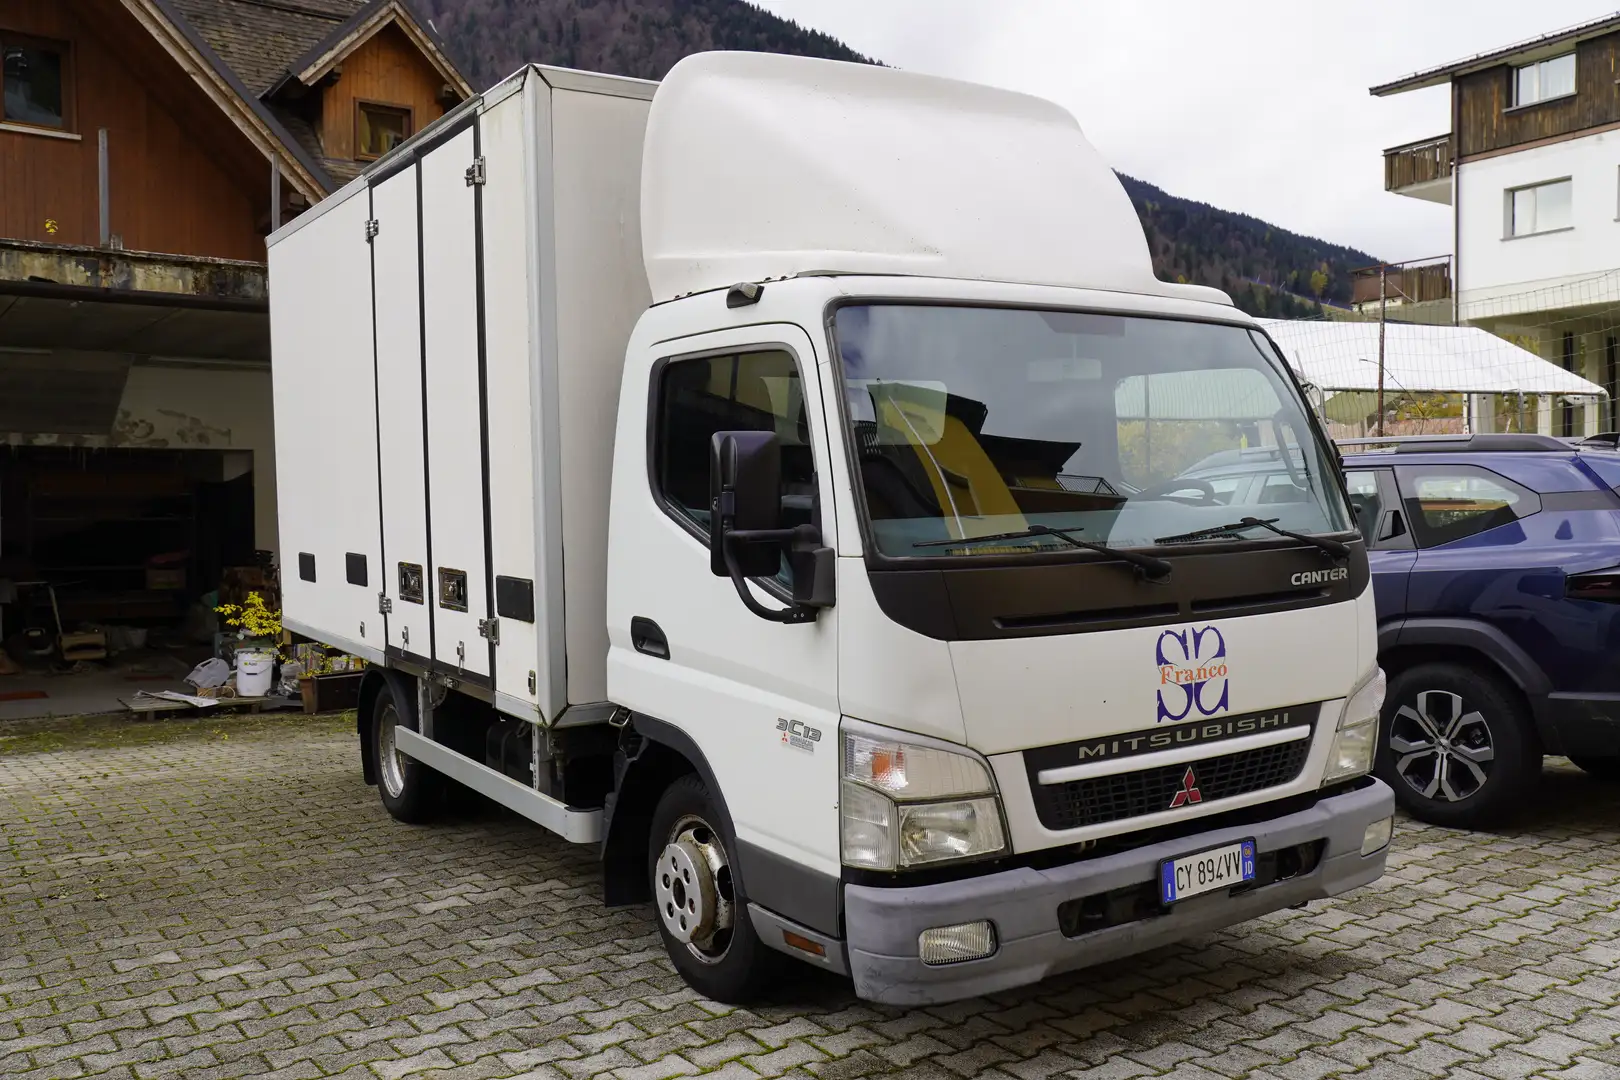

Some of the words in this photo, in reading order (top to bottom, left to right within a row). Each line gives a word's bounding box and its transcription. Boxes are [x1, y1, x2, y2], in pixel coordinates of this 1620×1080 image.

[1291, 567, 1348, 586] CANTER
[1161, 663, 1228, 685] Franco
[776, 717, 822, 742] 3C13
[1078, 712, 1289, 759] MITSUBISHI
[1176, 863, 1192, 892] CY
[1198, 850, 1241, 886] 894VV
